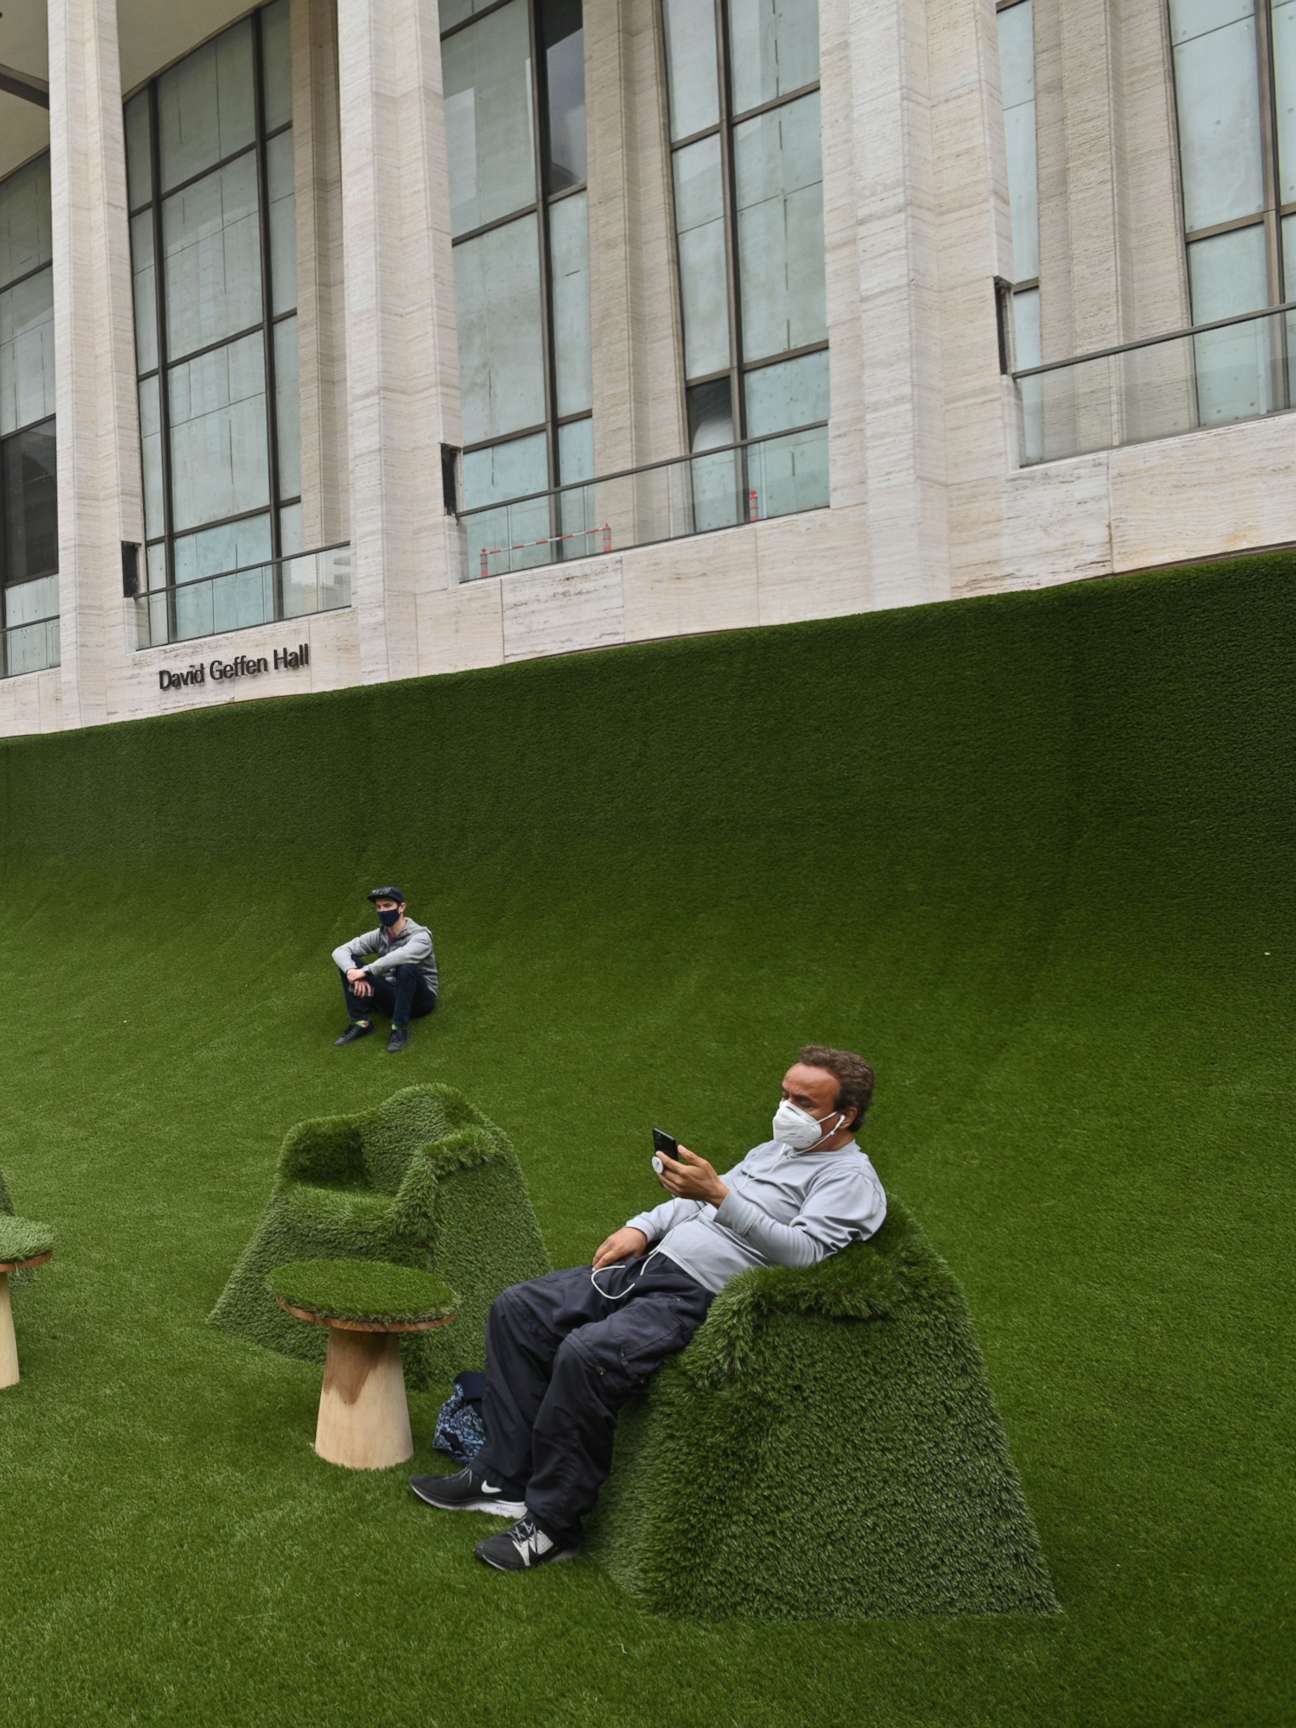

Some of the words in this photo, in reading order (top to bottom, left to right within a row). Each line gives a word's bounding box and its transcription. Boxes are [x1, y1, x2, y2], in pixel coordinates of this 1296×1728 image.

[159, 663, 205, 690] David
[209, 655, 268, 681] Geffen
[273, 643, 310, 670] Hall
